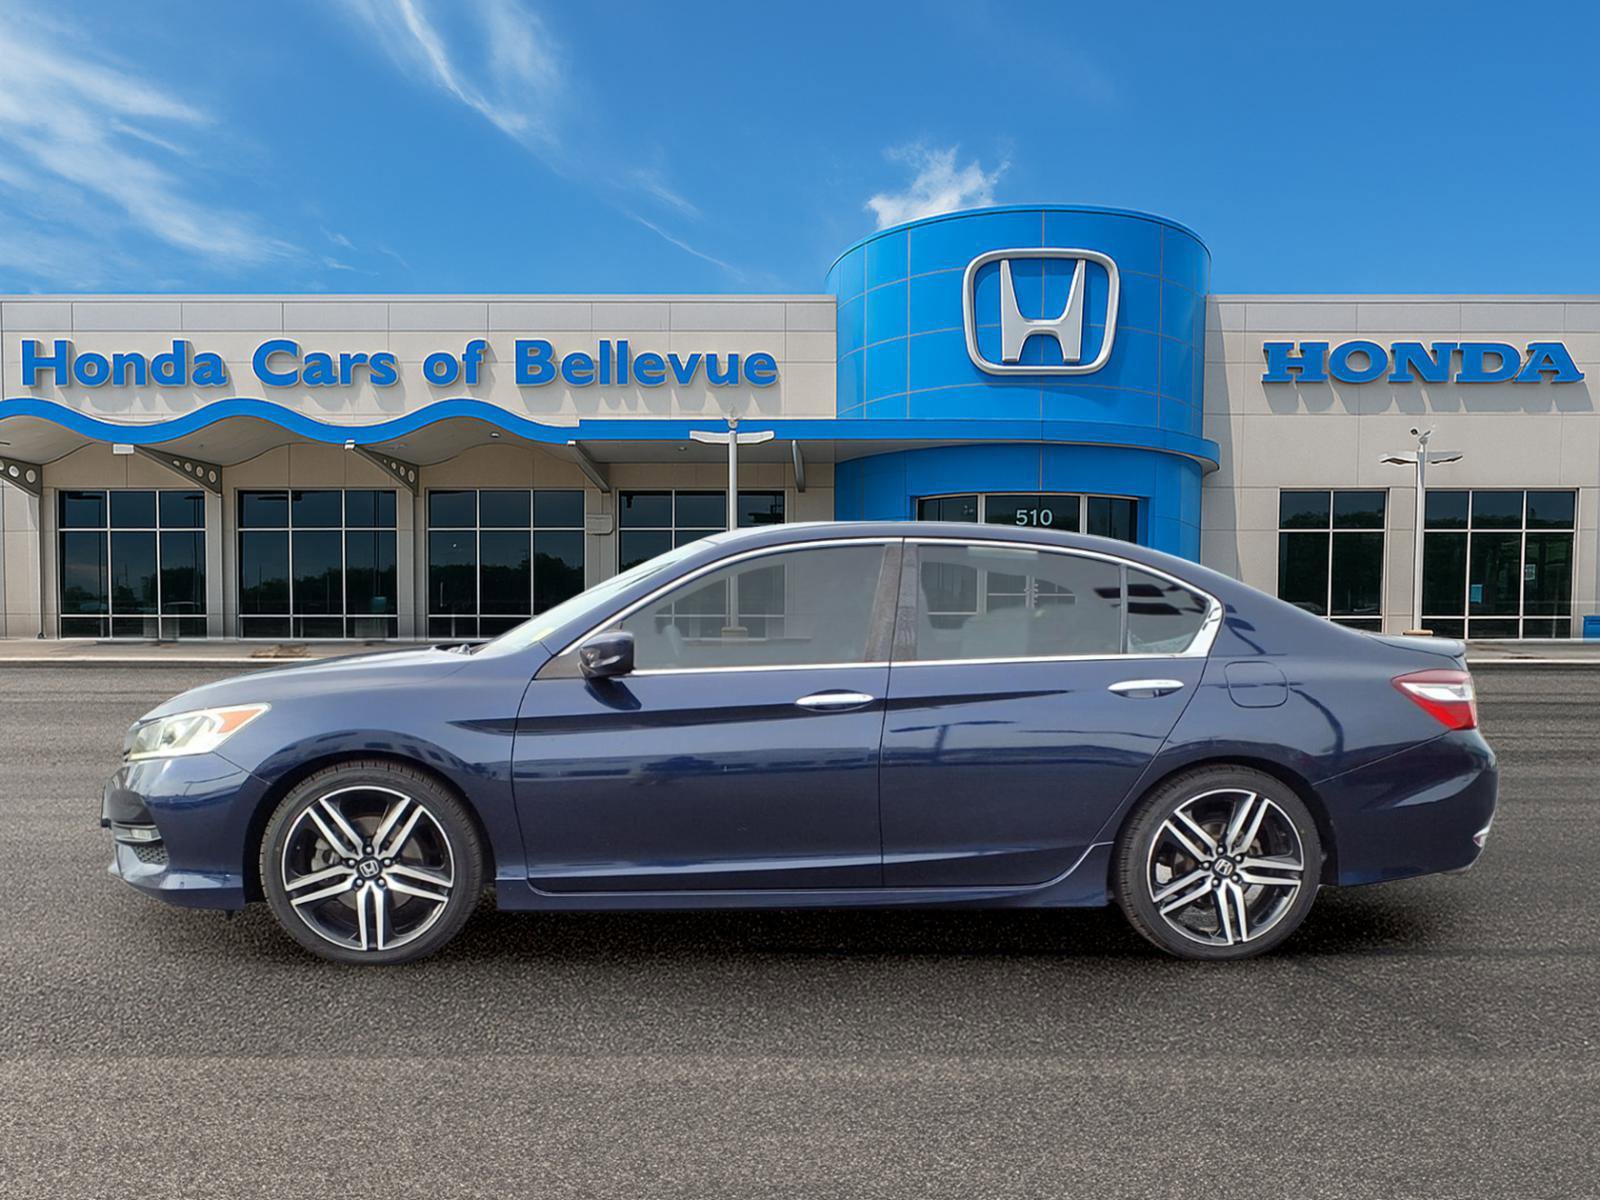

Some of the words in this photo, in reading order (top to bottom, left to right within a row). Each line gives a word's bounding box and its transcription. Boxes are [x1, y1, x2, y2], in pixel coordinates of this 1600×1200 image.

[21, 339, 228, 387] Honda
[252, 339, 398, 387] Cars
[423, 339, 486, 387] of
[515, 339, 778, 387] Bellevue
[1263, 340, 1585, 384] HONDA
[1015, 508, 1053, 526] 510
